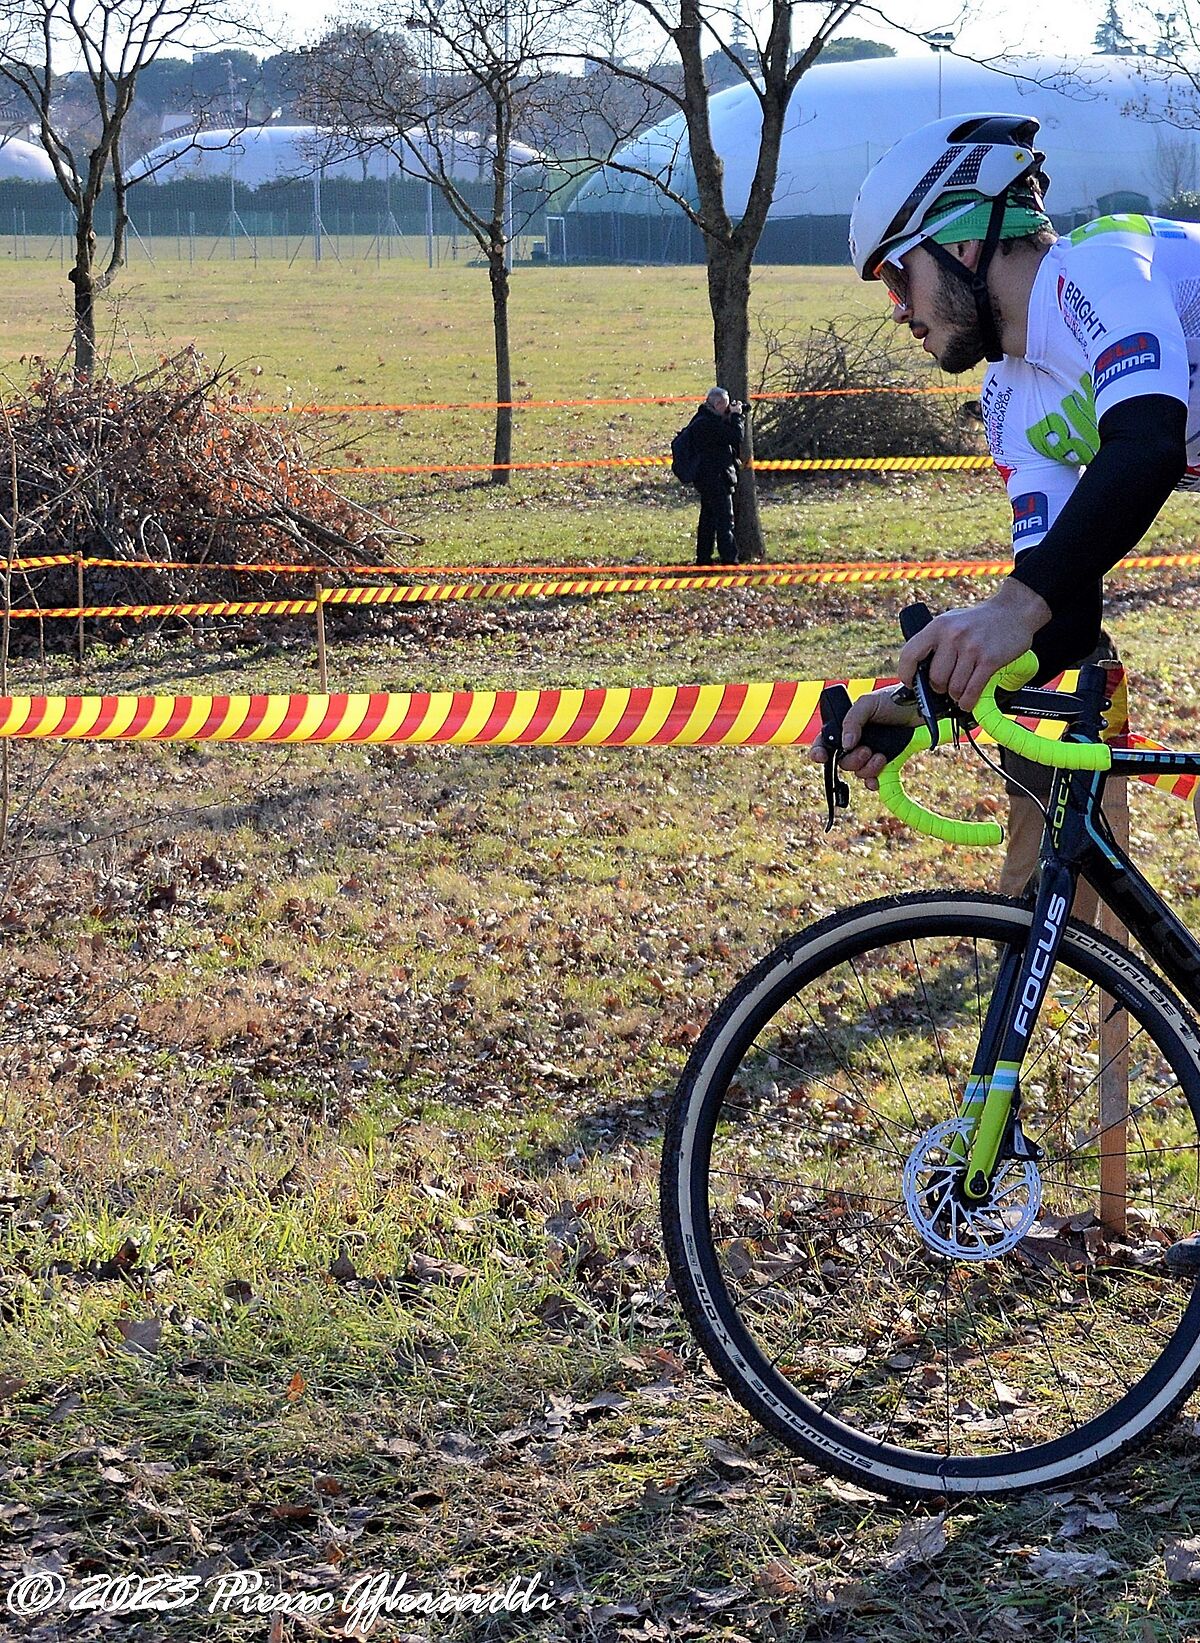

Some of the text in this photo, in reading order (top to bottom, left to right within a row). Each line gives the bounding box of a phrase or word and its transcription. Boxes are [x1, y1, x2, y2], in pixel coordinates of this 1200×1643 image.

[1065, 281, 1107, 341] BRIGHT
[1095, 352, 1156, 389] OMMA
[1014, 893, 1066, 1037] FOCUS
[1064, 926, 1177, 1018] SCHWALBE
[693, 1272, 874, 1469] SCHWALBE X-ONE
